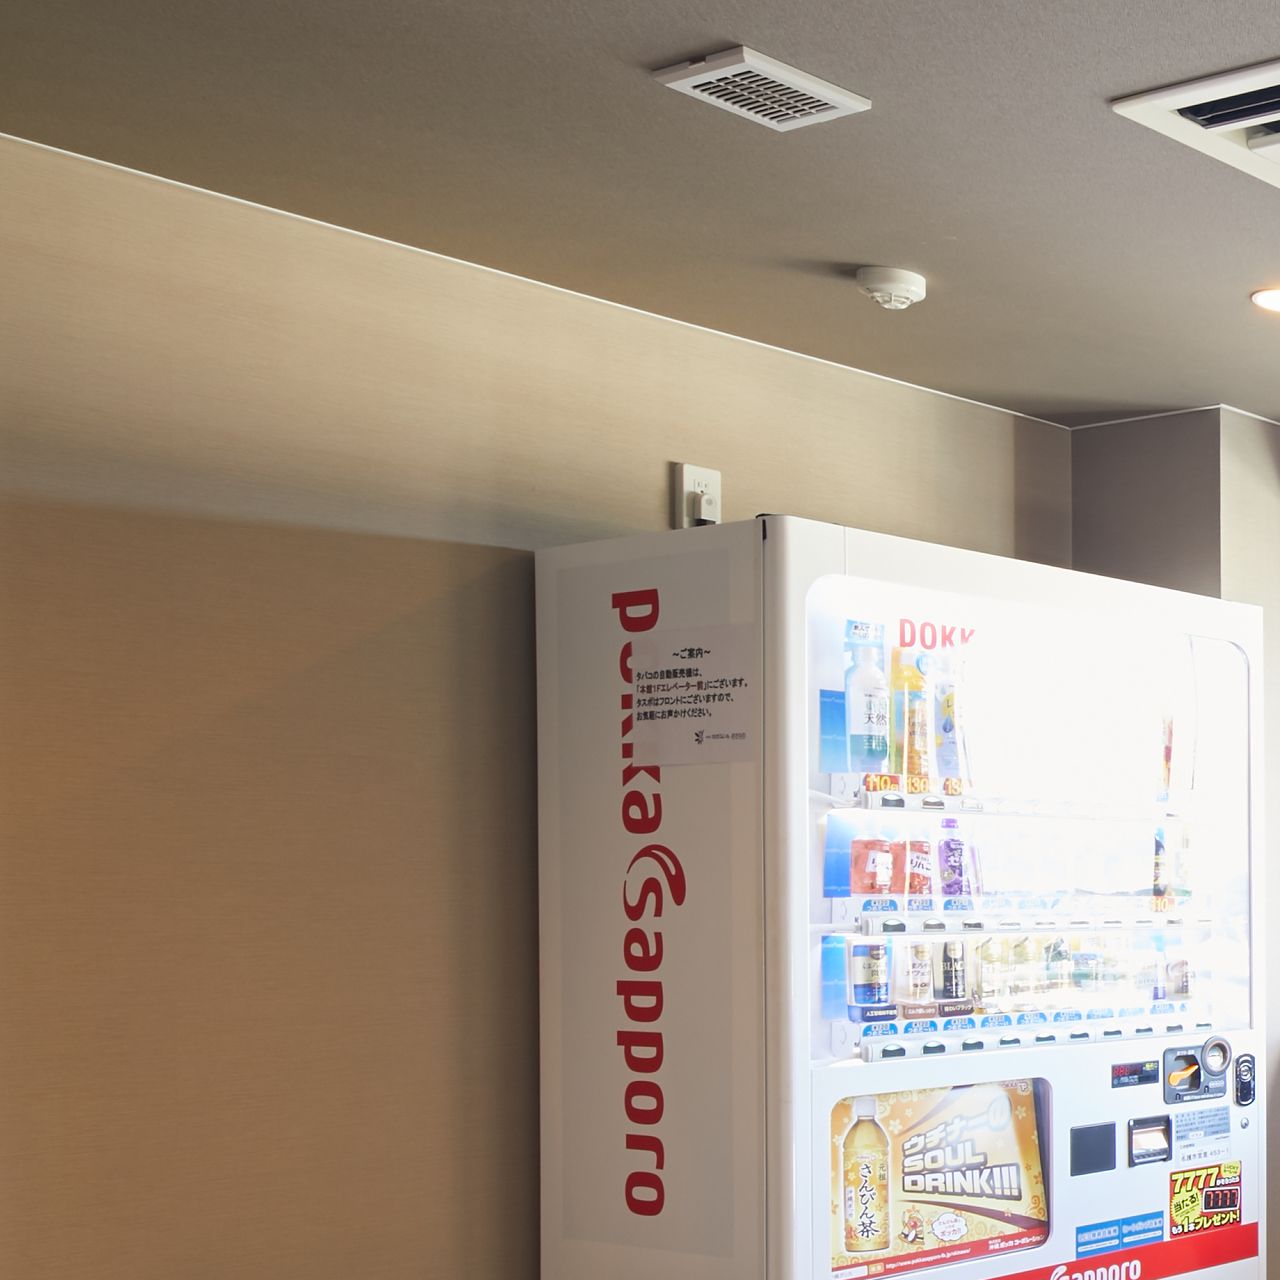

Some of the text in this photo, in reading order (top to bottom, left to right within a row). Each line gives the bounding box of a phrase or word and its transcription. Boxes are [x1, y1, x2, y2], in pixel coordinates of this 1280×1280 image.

[903, 1142, 985, 1172] SOUL
[903, 1164, 1020, 1197] DRINK!!!
[1171, 1167, 1219, 1193] 7777
[857, 1163, 879, 1238] さんぴん茶
